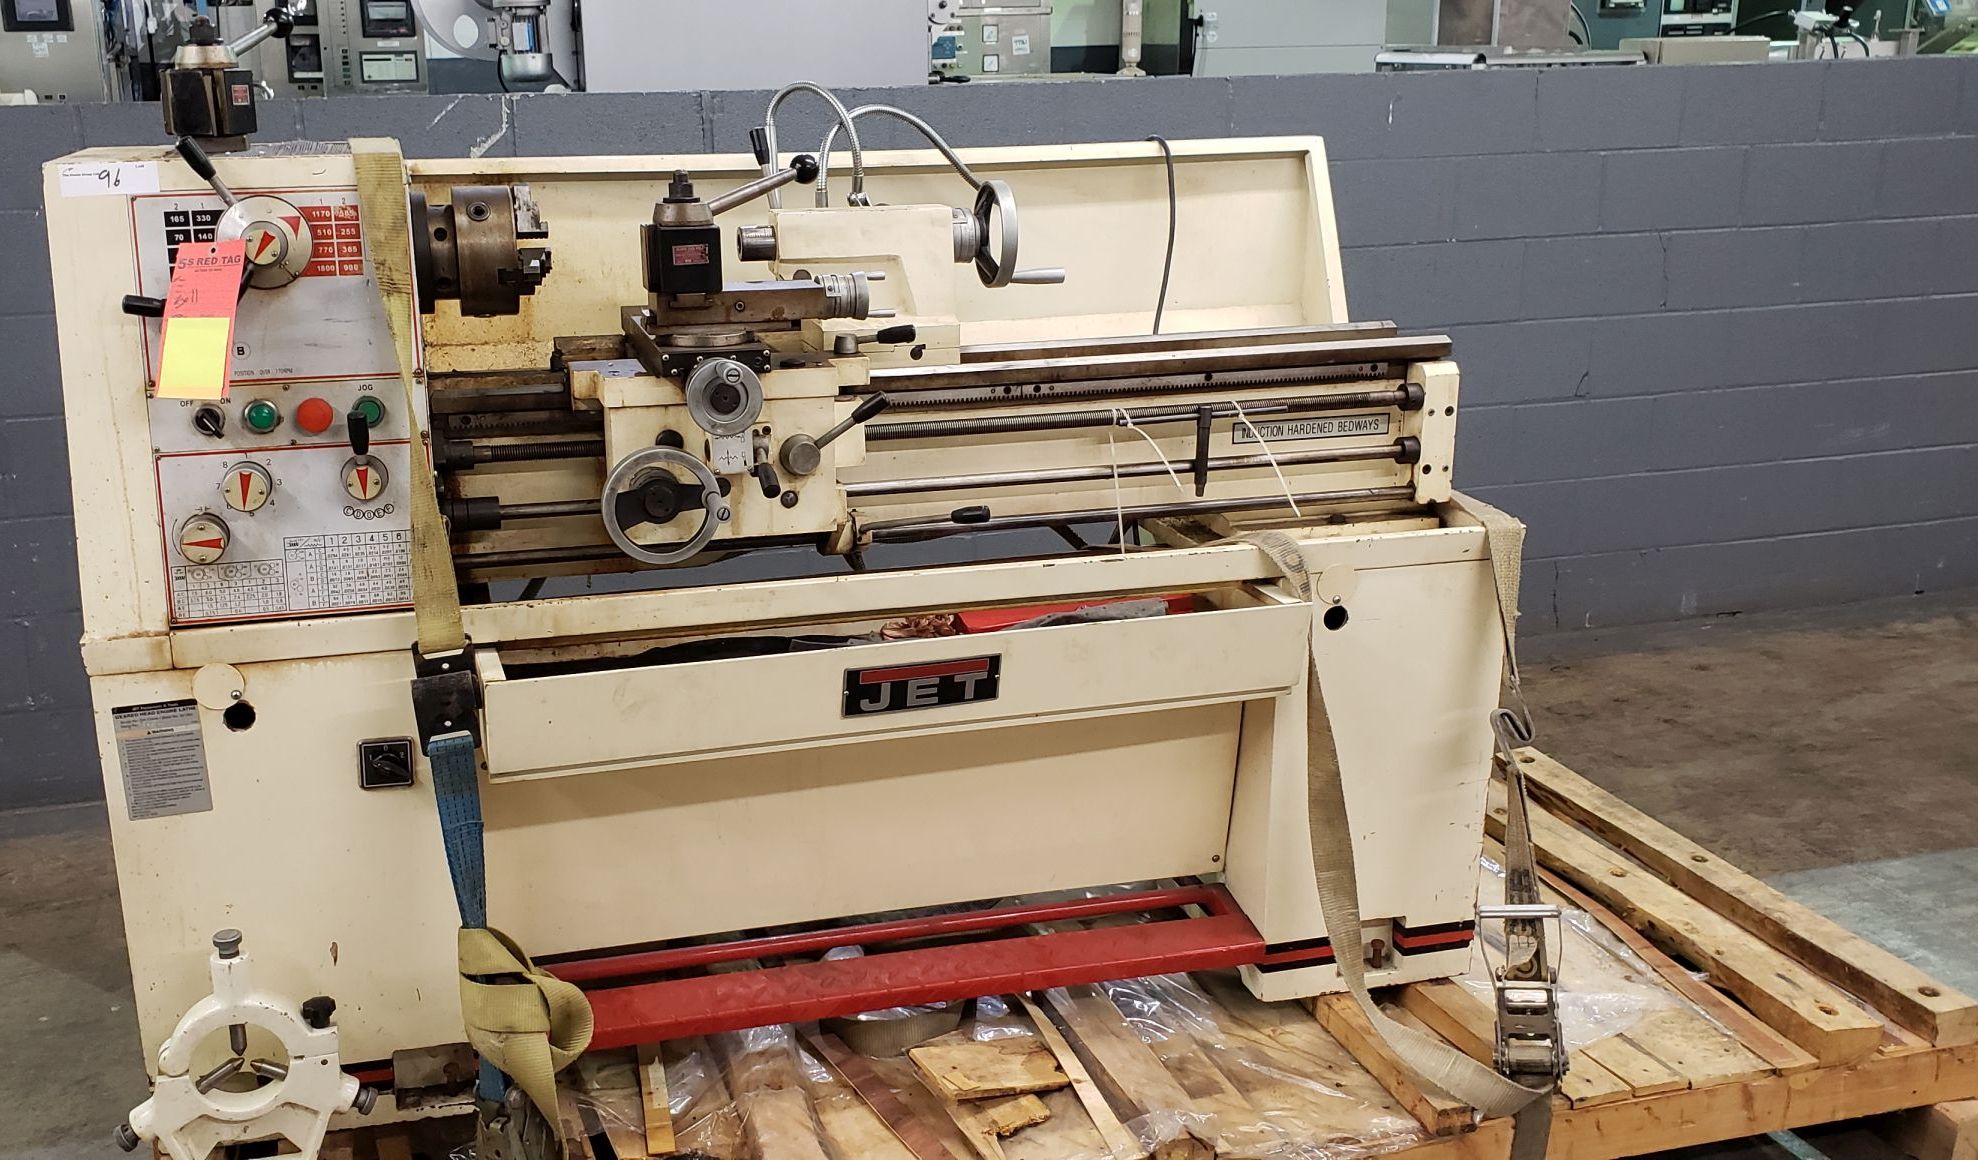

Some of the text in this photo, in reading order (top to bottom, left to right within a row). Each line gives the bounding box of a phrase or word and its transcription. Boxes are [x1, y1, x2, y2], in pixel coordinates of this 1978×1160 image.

[98, 168, 121, 189] 96
[311, 210, 330, 218] 1170
[169, 214, 211, 223] 165 330
[340, 228, 356, 236] 255
[197, 233, 213, 241] 140
[197, 257, 218, 265] RED
[221, 255, 241, 264] TAG
[236, 346, 245, 356] B
[357, 384, 374, 392] JOG
[179, 400, 194, 408] OFF
[1287, 422, 1334, 435] HARDENED
[1337, 418, 1380, 432] BEDWAYS
[222, 461, 228, 469] 8
[265, 458, 272, 466] 2
[215, 482, 221, 490] 7
[276, 478, 283, 486] 3
[268, 499, 275, 507] 4
[341, 537, 348, 545] 2
[355, 535, 362, 543] 3
[369, 534, 375, 542] 4
[382, 533, 389, 541] 5
[860, 672, 988, 711] JET
